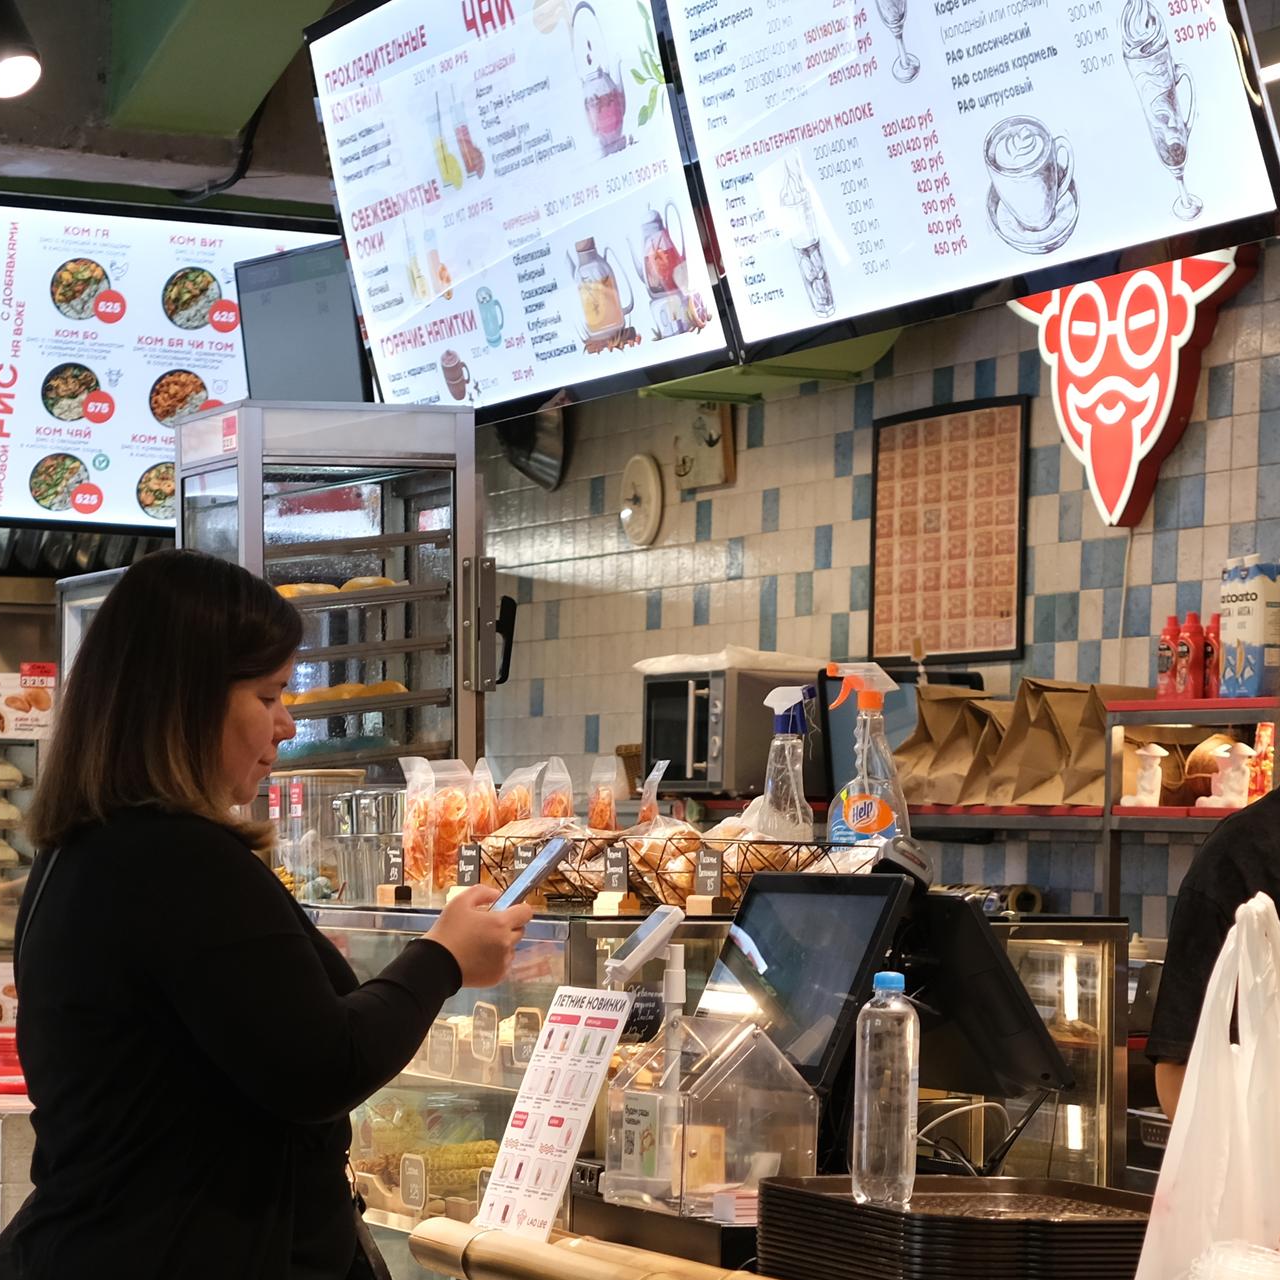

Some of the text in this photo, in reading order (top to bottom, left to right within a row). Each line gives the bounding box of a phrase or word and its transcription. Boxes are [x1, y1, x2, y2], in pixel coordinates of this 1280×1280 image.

[853, 7, 868, 30] руб
[857, 31, 874, 54] руб
[945, 17, 1217, 66] РАФ классический 300 330 руб
[324, 24, 427, 94] ПРОХЛАДИТЕЛЬНЫЕ
[862, 55, 879, 78] руб
[951, 44, 1102, 91] РАФ соленая карамель 300
[957, 79, 1035, 115] РАФ цитрусовый
[714, 101, 876, 169] КОФЕ НА АЛЬТЕРНАТИВНОМ МОЛОКЕ
[881, 116, 917, 138] 320\420
[917, 107, 934, 130] руб
[652, 159, 669, 177] РУБ
[720, 171, 755, 193] Капучино
[921, 128, 939, 151] руб
[725, 151, 946, 211] Латте 200 380 руб
[845, 171, 951, 216] 300 420 руб
[351, 178, 441, 232] СВЕЖЕВЫЖАТЫЕ
[850, 192, 957, 237] 300 390 руб
[63, 225, 110, 239] КОМ ГА
[169, 233, 225, 249] КОМ ВИТ
[856, 213, 962, 257] 300 400 руб
[2, 221, 19, 309] ДОБАВКАМИ
[861, 261, 881, 277] 300
[933, 241, 951, 257] 450
[950, 234, 968, 256] руб
[10, 300, 26, 358] НА ВОКЕ
[212, 310, 236, 322] 625
[54, 328, 99, 340] КОМ БО
[136, 335, 235, 352] КОМ БА ЧИ ТОМ
[380, 325, 426, 358] ГОРЯЧИЕ
[425, 309, 478, 345] НАПИТКИ
[86, 402, 109, 413] 575
[34, 425, 93, 440] КОМ ЧАЙ
[131, 432, 159, 445] КОМ
[852, 800, 873, 823] Help
[553, 993, 627, 1013] ЛЕТНИЕ НОВИНКИ
